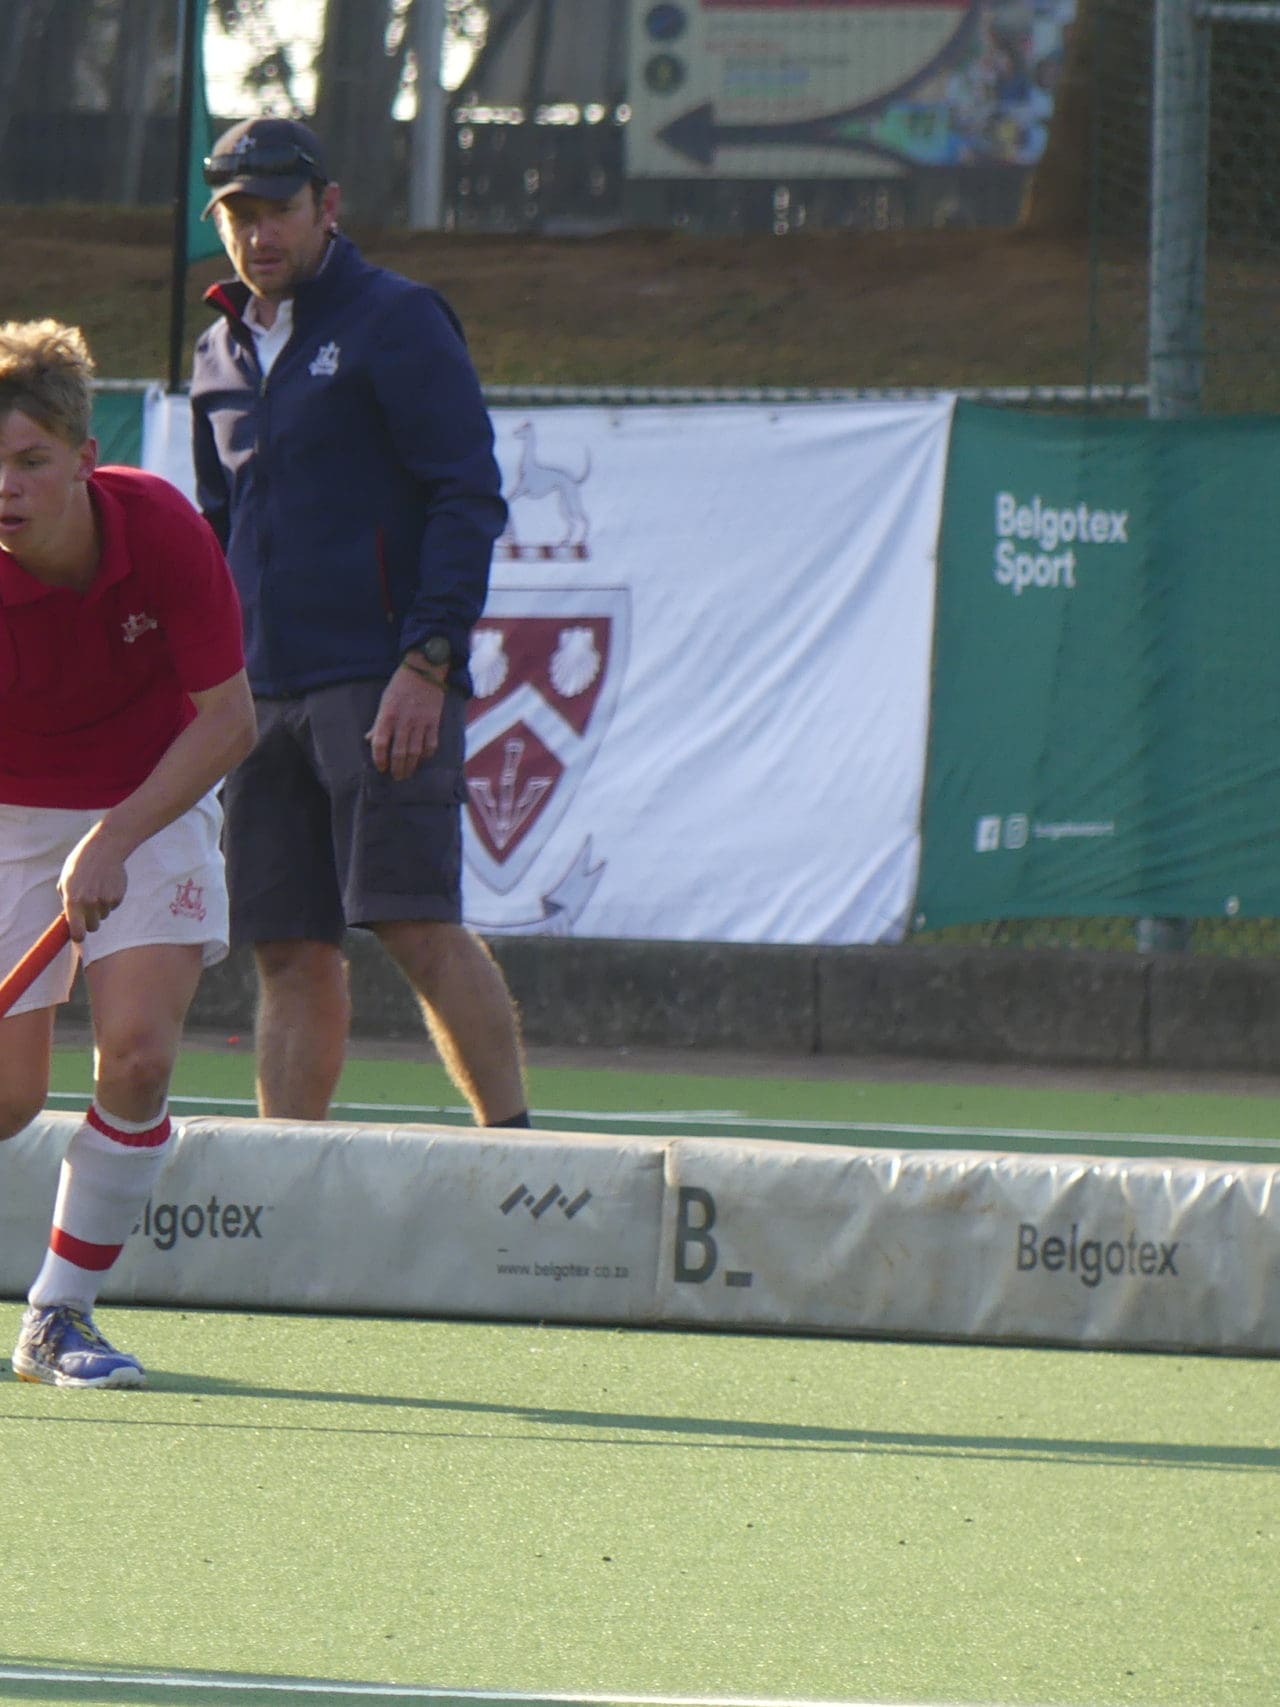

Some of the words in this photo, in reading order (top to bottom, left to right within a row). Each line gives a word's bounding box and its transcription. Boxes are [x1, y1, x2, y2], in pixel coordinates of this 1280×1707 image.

[994, 491, 1129, 549] Belgotex
[993, 539, 1077, 595] Sport
[131, 1195, 265, 1250] lgotex
[1016, 1223, 1179, 1288] Belgotex
